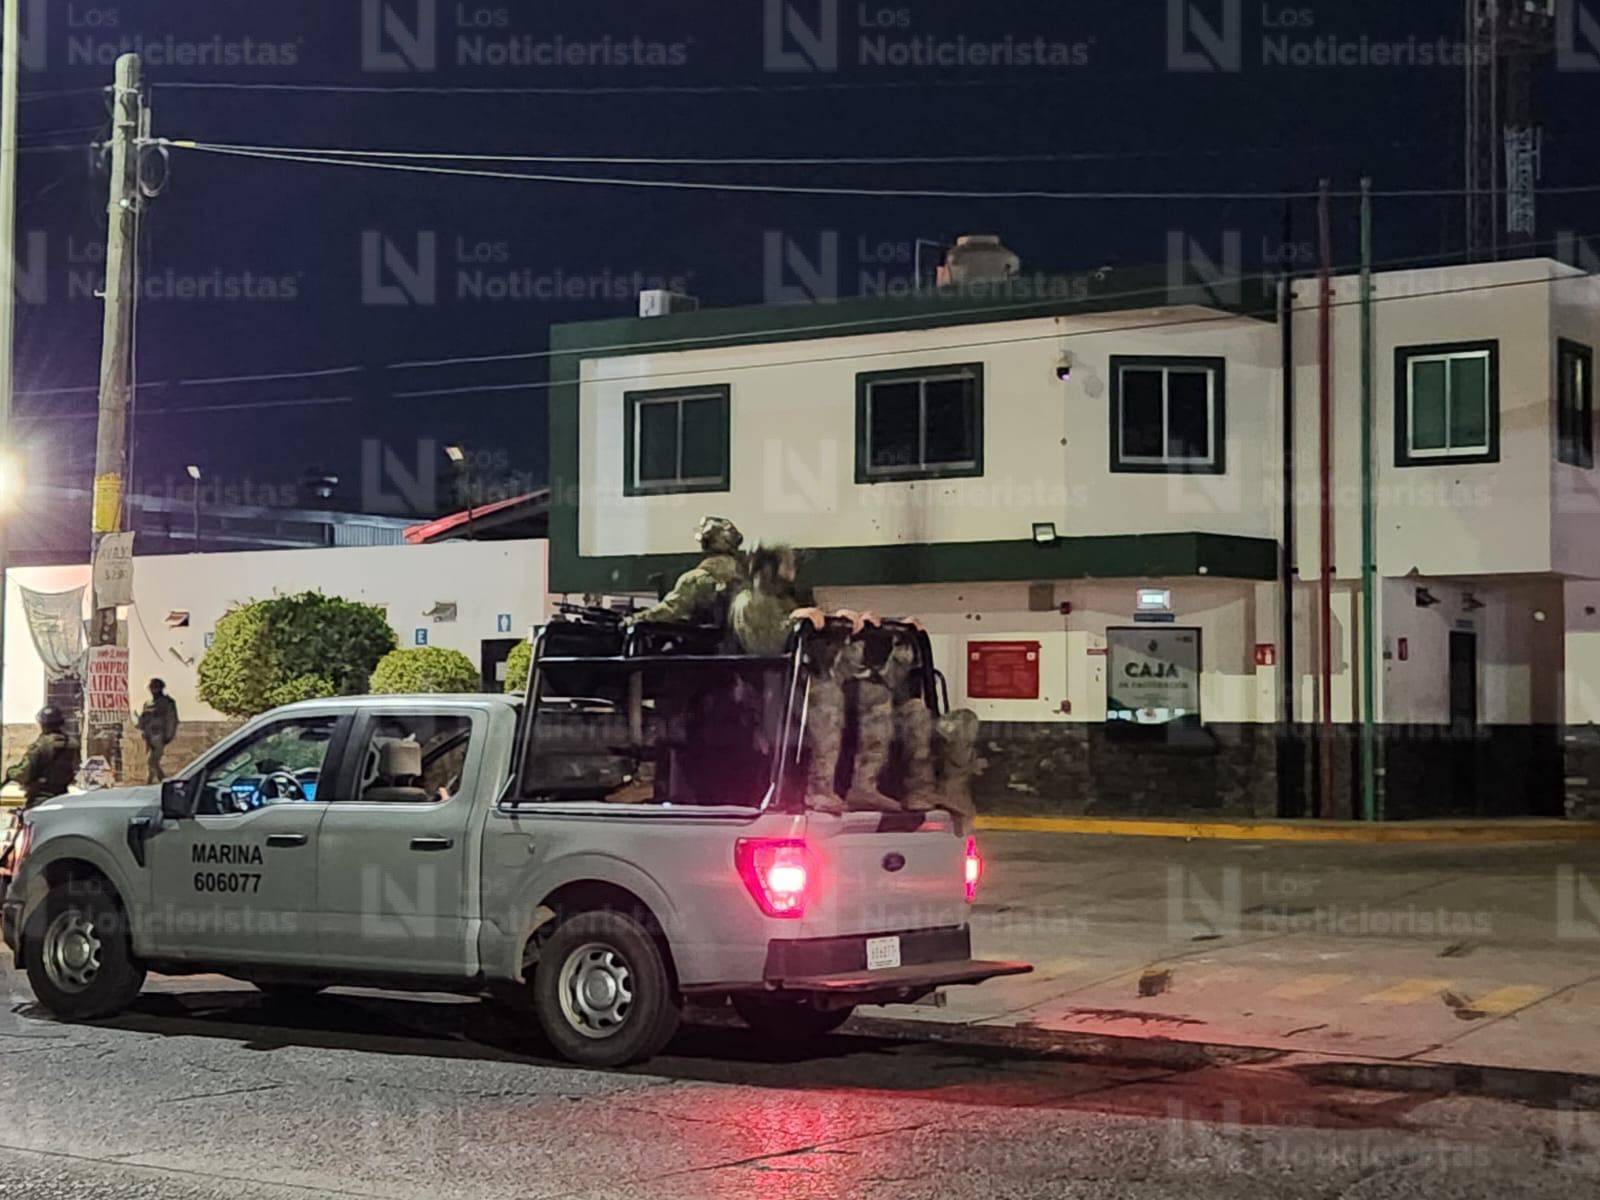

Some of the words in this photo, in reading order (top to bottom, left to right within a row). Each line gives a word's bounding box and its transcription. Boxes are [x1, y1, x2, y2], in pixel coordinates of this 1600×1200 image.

[89, 661, 129, 673] COMPRO
[1124, 662, 1180, 678] CAJA
[89, 675, 129, 691] AIRES
[89, 693, 130, 709] VIEJOS
[192, 843, 263, 865] MARINA
[194, 872, 262, 893] 606077
